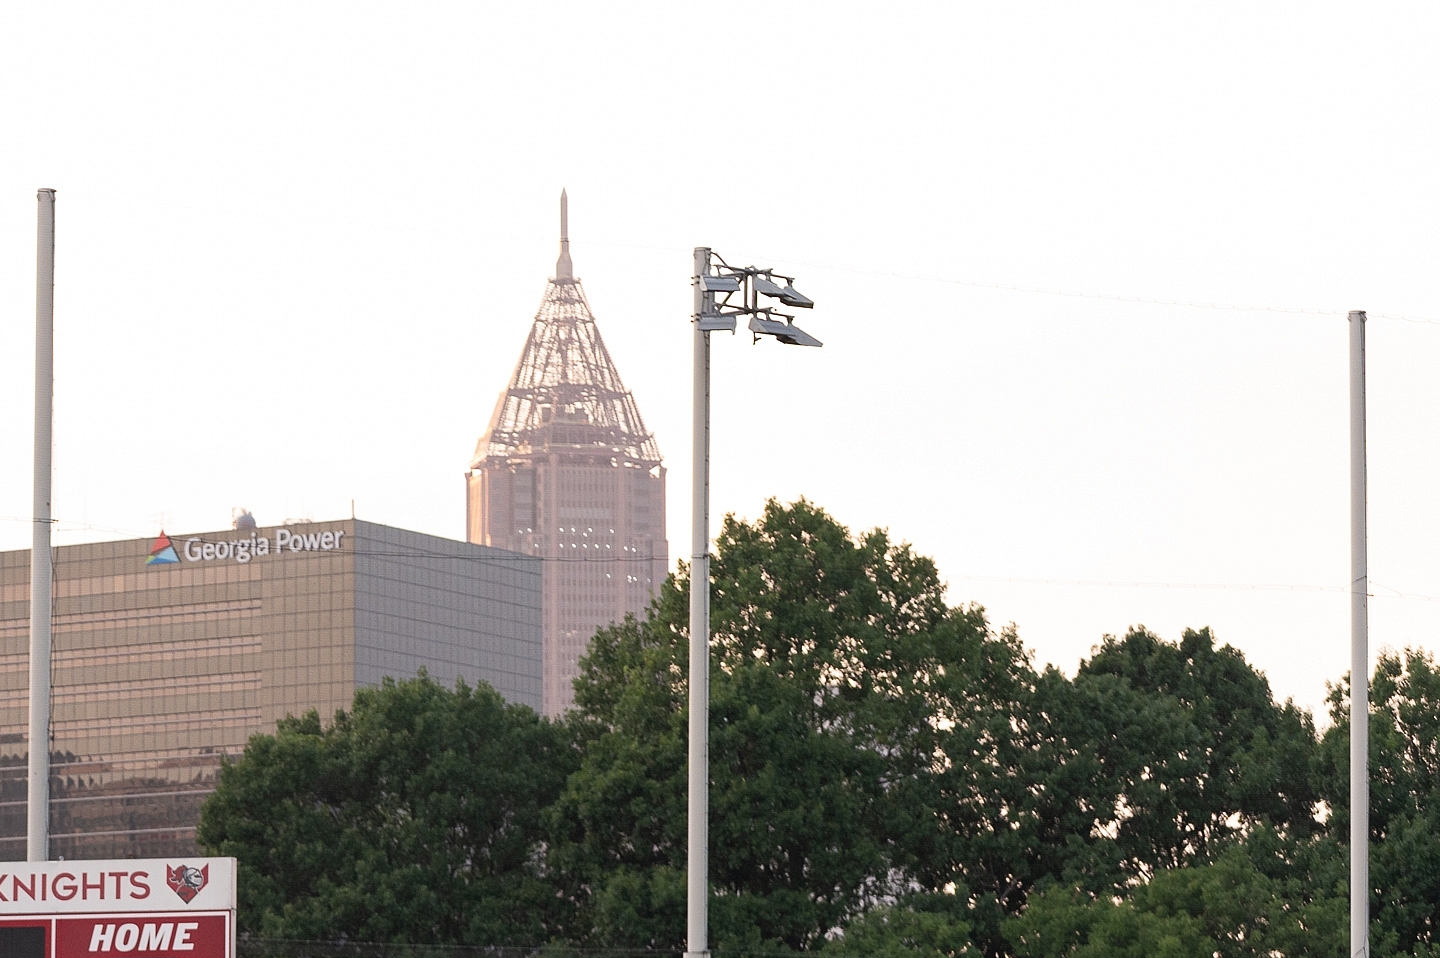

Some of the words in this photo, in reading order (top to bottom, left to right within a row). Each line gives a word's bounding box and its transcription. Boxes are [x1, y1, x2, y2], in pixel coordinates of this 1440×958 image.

[183, 531, 271, 563] Georgia
[275, 528, 346, 554] Power
[88, 922, 199, 953] HOME
